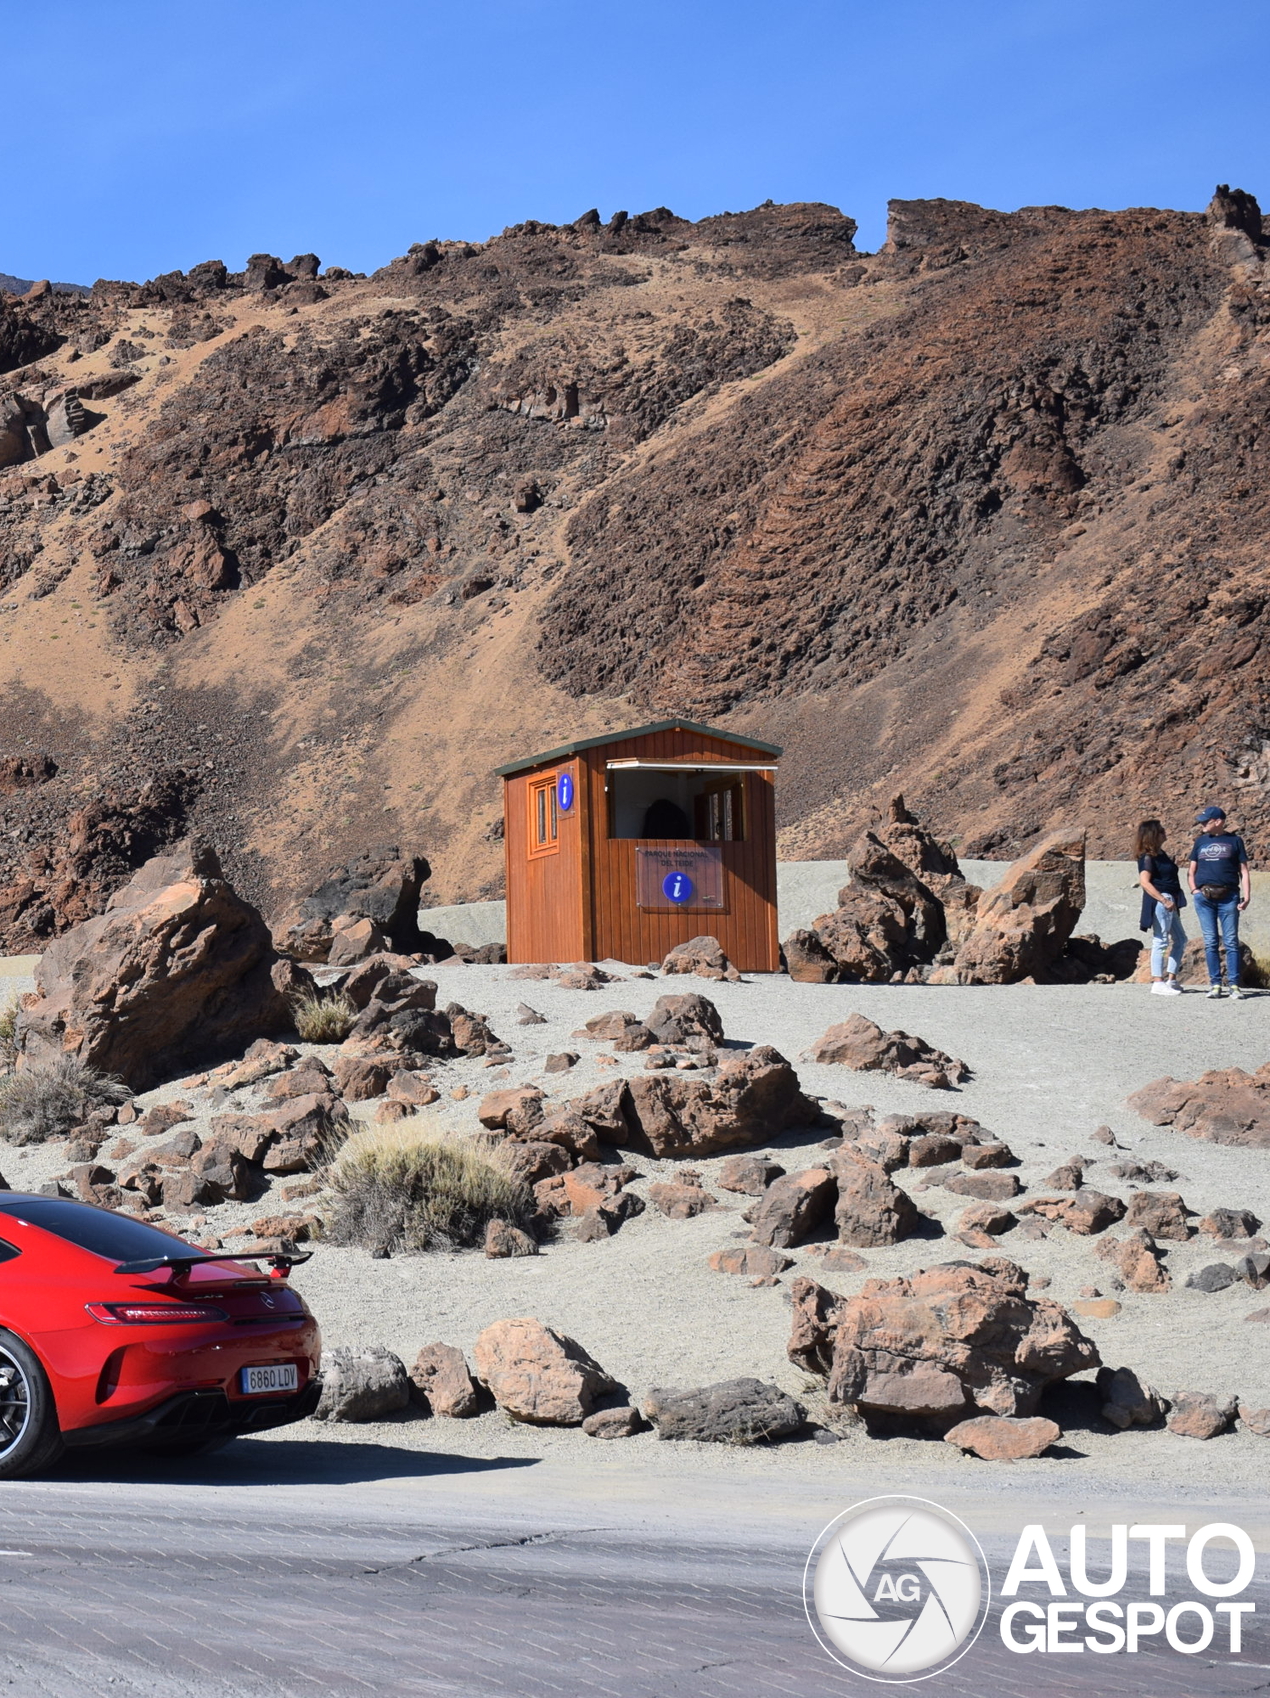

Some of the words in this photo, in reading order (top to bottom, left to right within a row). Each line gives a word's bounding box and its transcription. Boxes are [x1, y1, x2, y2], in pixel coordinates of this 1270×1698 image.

[645, 850, 672, 858] PARQUE
[250, 1369, 276, 1389] 6860
[278, 1367, 295, 1387] LDV
